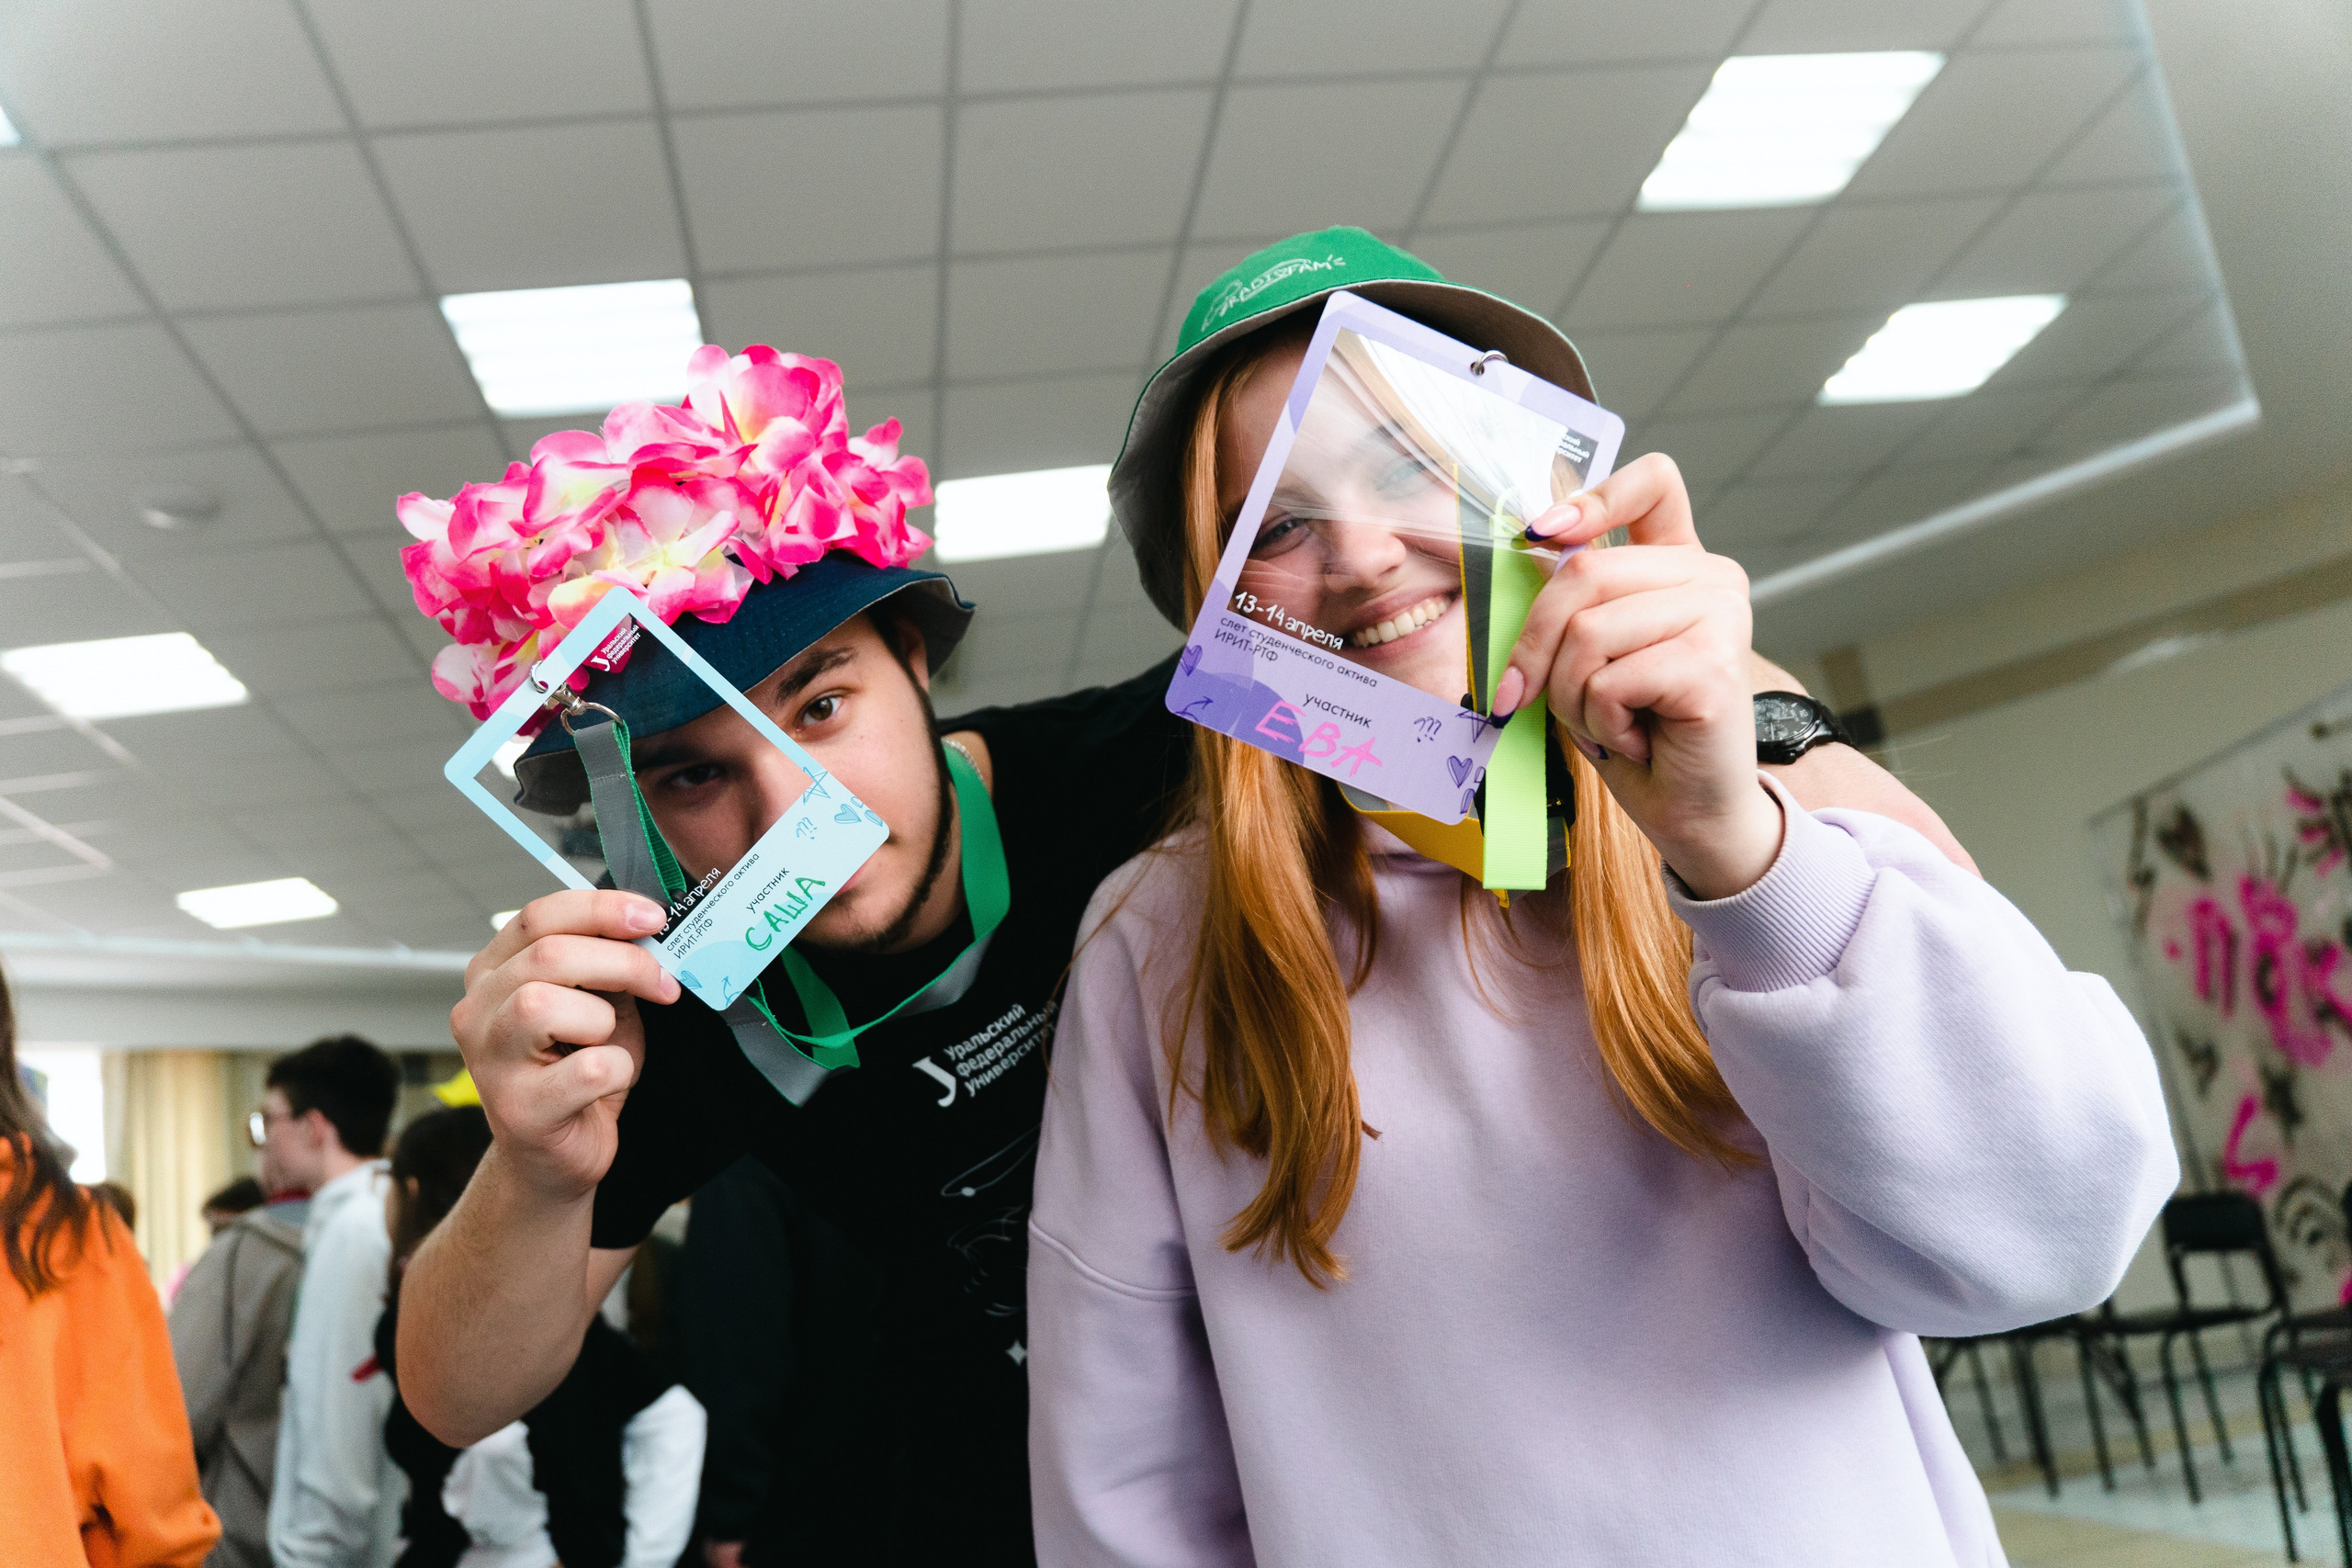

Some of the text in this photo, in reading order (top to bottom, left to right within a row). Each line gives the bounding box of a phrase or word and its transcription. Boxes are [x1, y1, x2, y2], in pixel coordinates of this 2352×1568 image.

[601, 627, 628, 654] Уральский
[606, 624, 639, 660] федеральный
[1235, 591, 1344, 651] 13-14 апреля
[611, 632, 641, 665] университет
[1214, 628, 1279, 662] ИРИТ-РТФ
[1220, 616, 1377, 688] слет студенческого актива
[1301, 693, 1373, 728] участник
[1255, 700, 1383, 777] ЕВА
[666, 853, 760, 952] слет студенческого актива
[683, 867, 721, 907] апреля
[746, 867, 790, 914] участник
[745, 877, 826, 952] САША
[673, 918, 713, 960] ИРИТ-РТФ
[944, 1003, 1026, 1061] Уральский
